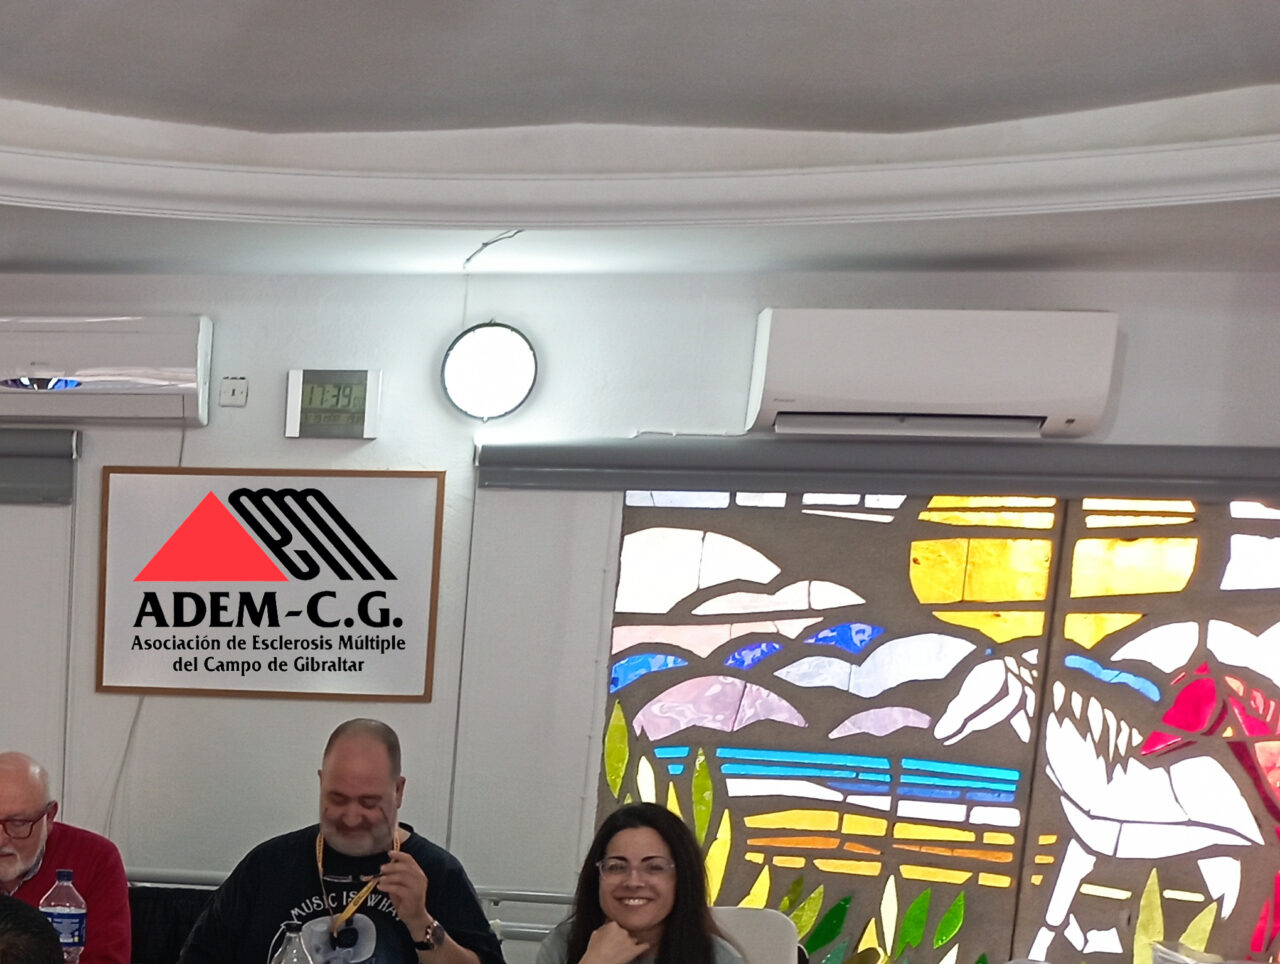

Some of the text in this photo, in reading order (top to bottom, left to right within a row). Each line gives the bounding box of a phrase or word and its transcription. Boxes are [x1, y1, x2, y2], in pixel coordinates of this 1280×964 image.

[133, 590, 403, 628] ADEM-C.G.
[131, 634, 406, 654] Asociación de Esclerosis Múltiple
[172, 656, 365, 676] del Campo de Gibraltar
[367, 893, 400, 920] WHA
